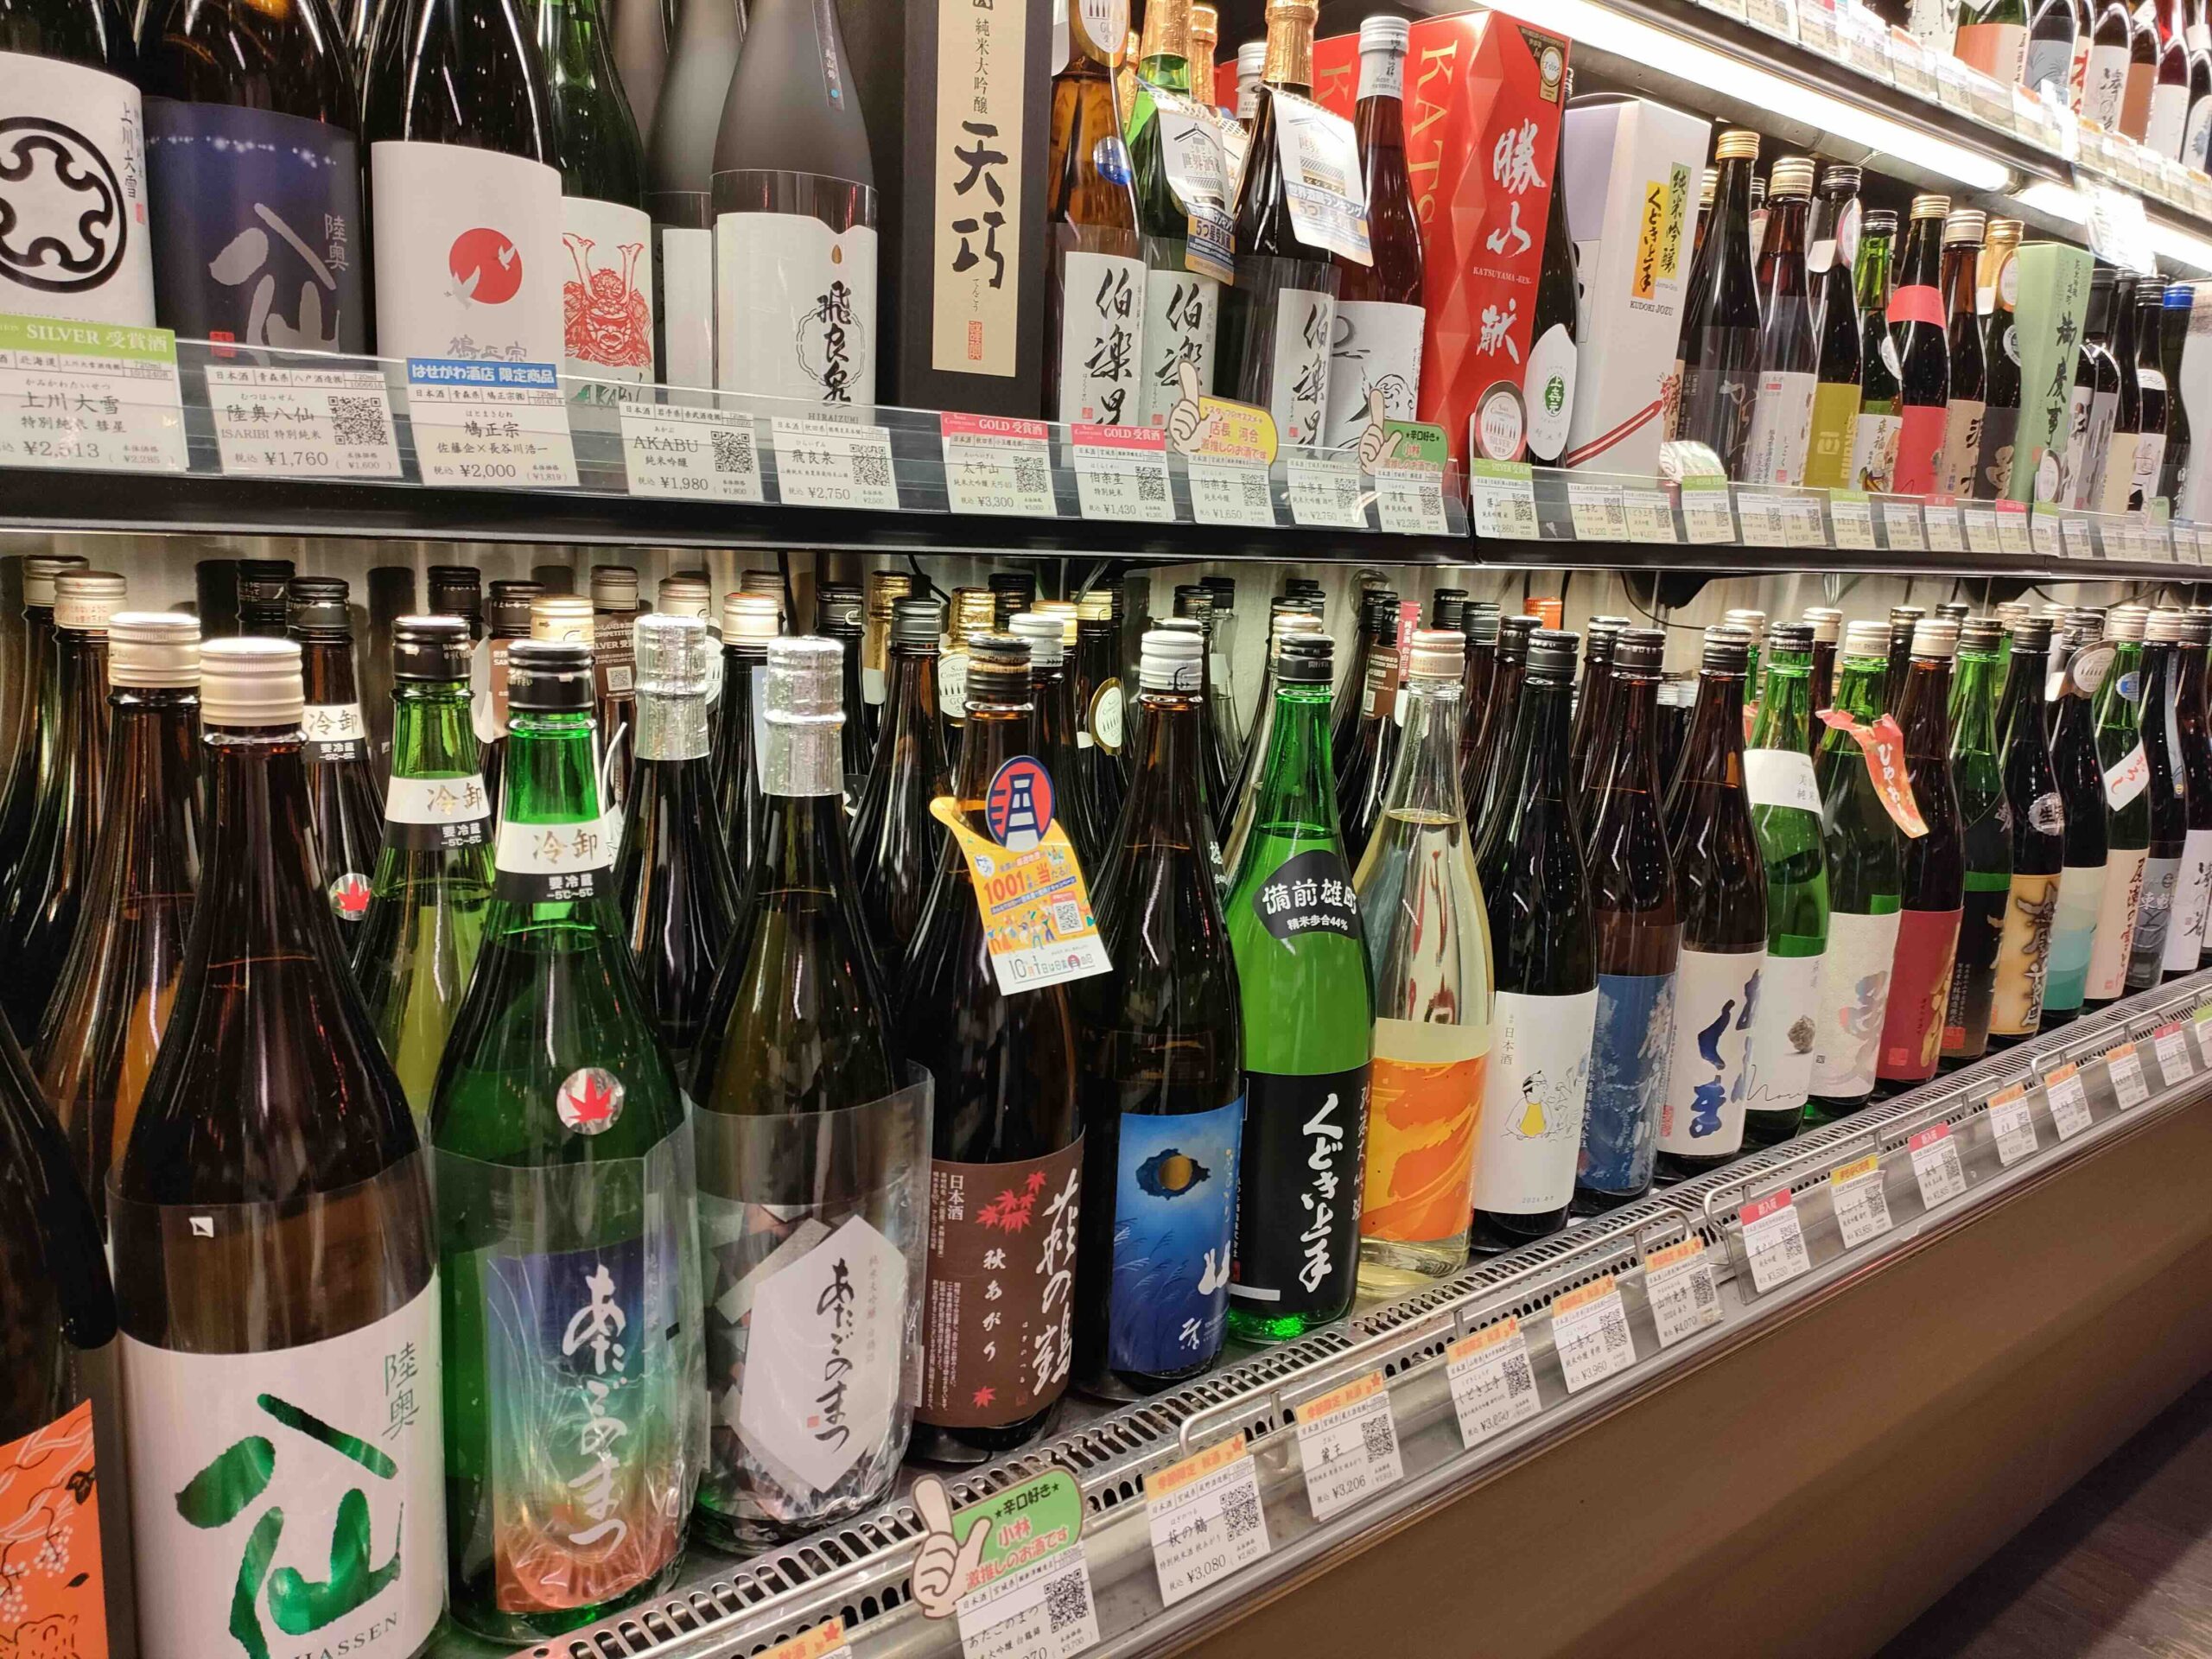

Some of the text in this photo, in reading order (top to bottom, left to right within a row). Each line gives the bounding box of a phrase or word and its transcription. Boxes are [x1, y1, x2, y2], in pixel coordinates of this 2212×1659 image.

[973, 17, 990, 115] 純米大吟醸
[120, 101, 137, 199] 上川大雪
[952, 120, 1009, 290] 天巧
[324, 213, 349, 272] 陸奥
[1472, 266, 1516, 283] KATSUYAMA
[26, 324, 100, 346] SILVER
[106, 329, 168, 353] 受賞酒
[215, 371, 249, 382] 日本酒
[259, 373, 289, 383] 青森県
[411, 364, 555, 384] はせがわ酒店 限定商品
[416, 389, 445, 398] 日本酒
[452, 390, 480, 399] 青森県
[21, 391, 120, 415] 上川大雪
[625, 404, 651, 416] 日本酒
[226, 404, 315, 423] 陸奥八仙
[808, 412, 860, 424] HIRAIZUMI
[221, 429, 270, 440] ISARIBI
[464, 421, 520, 439] 鳩正宗
[778, 421, 799, 430] 日本酒
[979, 418, 1010, 431] GOLD
[1012, 420, 1044, 436] 受賞酒
[1209, 421, 1231, 437] 店長
[633, 435, 699, 453] AKABU
[1103, 428, 1132, 439] GOLD
[1133, 428, 1160, 442] 受賞酒
[23, 441, 100, 459] ¥2,513
[791, 448, 835, 465] 飛良泉
[264, 452, 329, 467] ¥1,760
[645, 455, 689, 467] 純米吟醸
[963, 461, 1000, 474] 太平山
[460, 464, 517, 479] ¥2,000
[660, 476, 709, 491] ¥1,980
[808, 486, 851, 500] ¥2,750
[977, 496, 1014, 508] ¥3,300
[1103, 504, 1137, 515] ¥1,430
[1212, 508, 1243, 519] ¥1,650
[308, 709, 359, 735] 冷卸
[426, 780, 484, 817] 冷卸
[531, 826, 599, 866] 冷卸
[548, 871, 594, 891] 要冷蔵
[1262, 878, 1357, 916] 備前雄町
[1287, 913, 1349, 931] 精米歩合44%
[1500, 1026, 1515, 1066] 日本酒
[947, 1174, 965, 1221] 日本酒
[1299, 1093, 1344, 1293] くどき上手
[982, 1249, 1007, 1362] 秋あがり
[382, 1341, 421, 1441] 陸奥
[1331, 1474, 1366, 1499] ¥3,206
[1002, 1484, 1052, 1516] 辛口好き
[1152, 1499, 1173, 1514] 日本酒
[998, 1516, 1032, 1548] 小林
[965, 1527, 1069, 1590] 激推しのお酒です
[1186, 1554, 1227, 1584] ¥3,080
[963, 1592, 987, 1609] 日本酒
